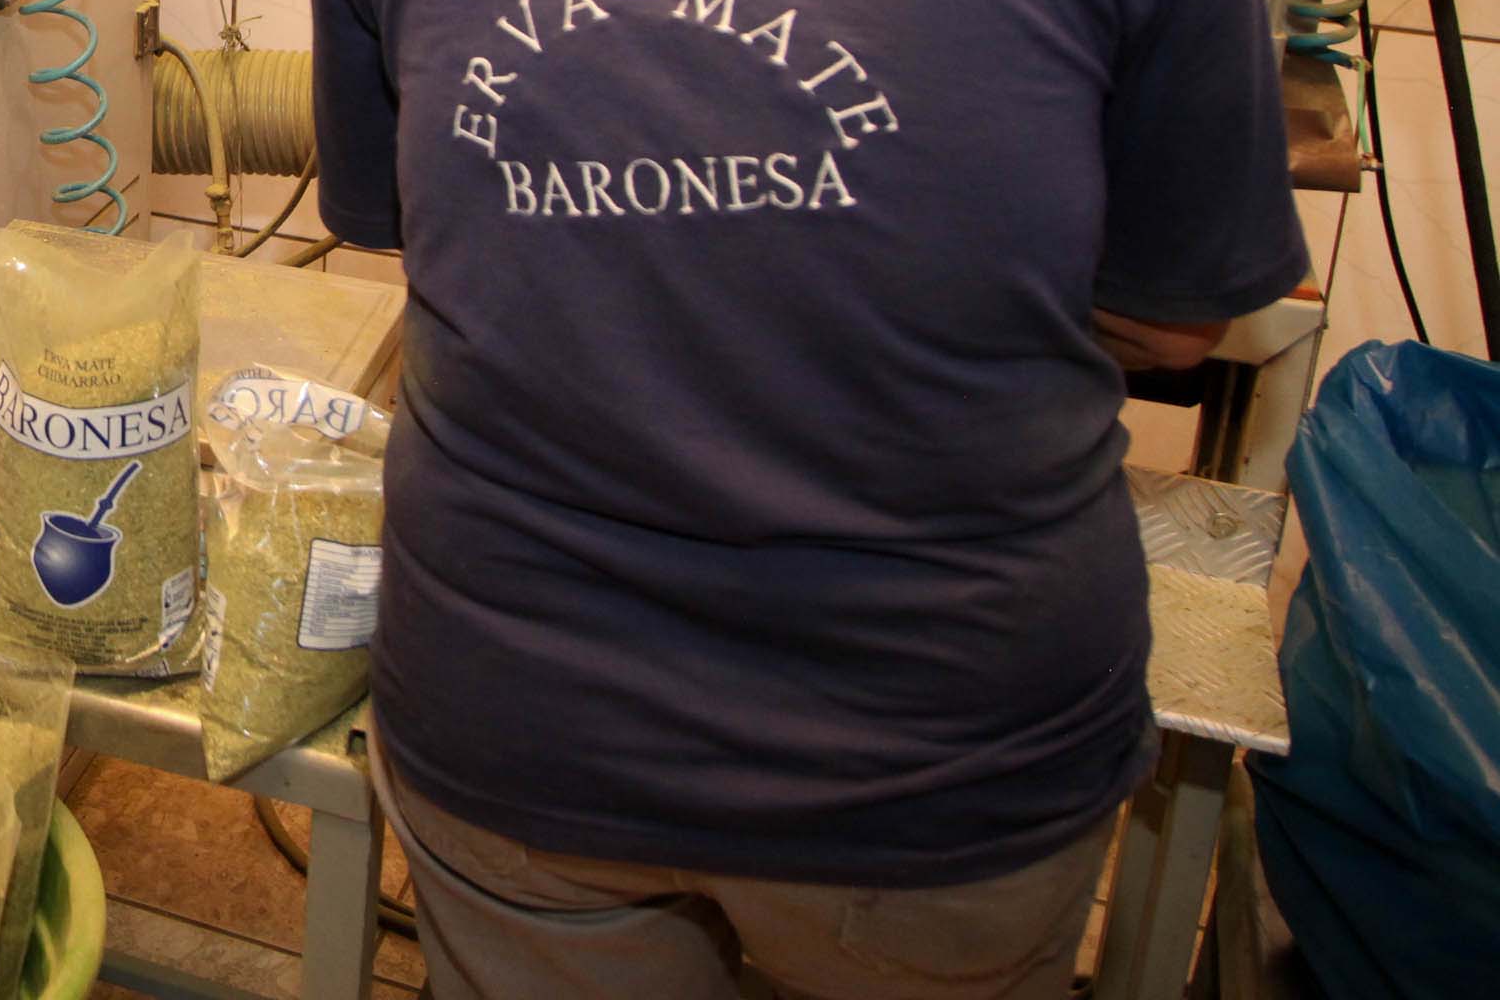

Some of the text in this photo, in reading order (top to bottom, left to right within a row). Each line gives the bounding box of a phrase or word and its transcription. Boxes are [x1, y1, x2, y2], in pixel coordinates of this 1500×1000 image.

[496, 150, 858, 217] BARONESA
[37, 364, 122, 388] CHIMARRÃO
[75, 357, 116, 372] MATE
